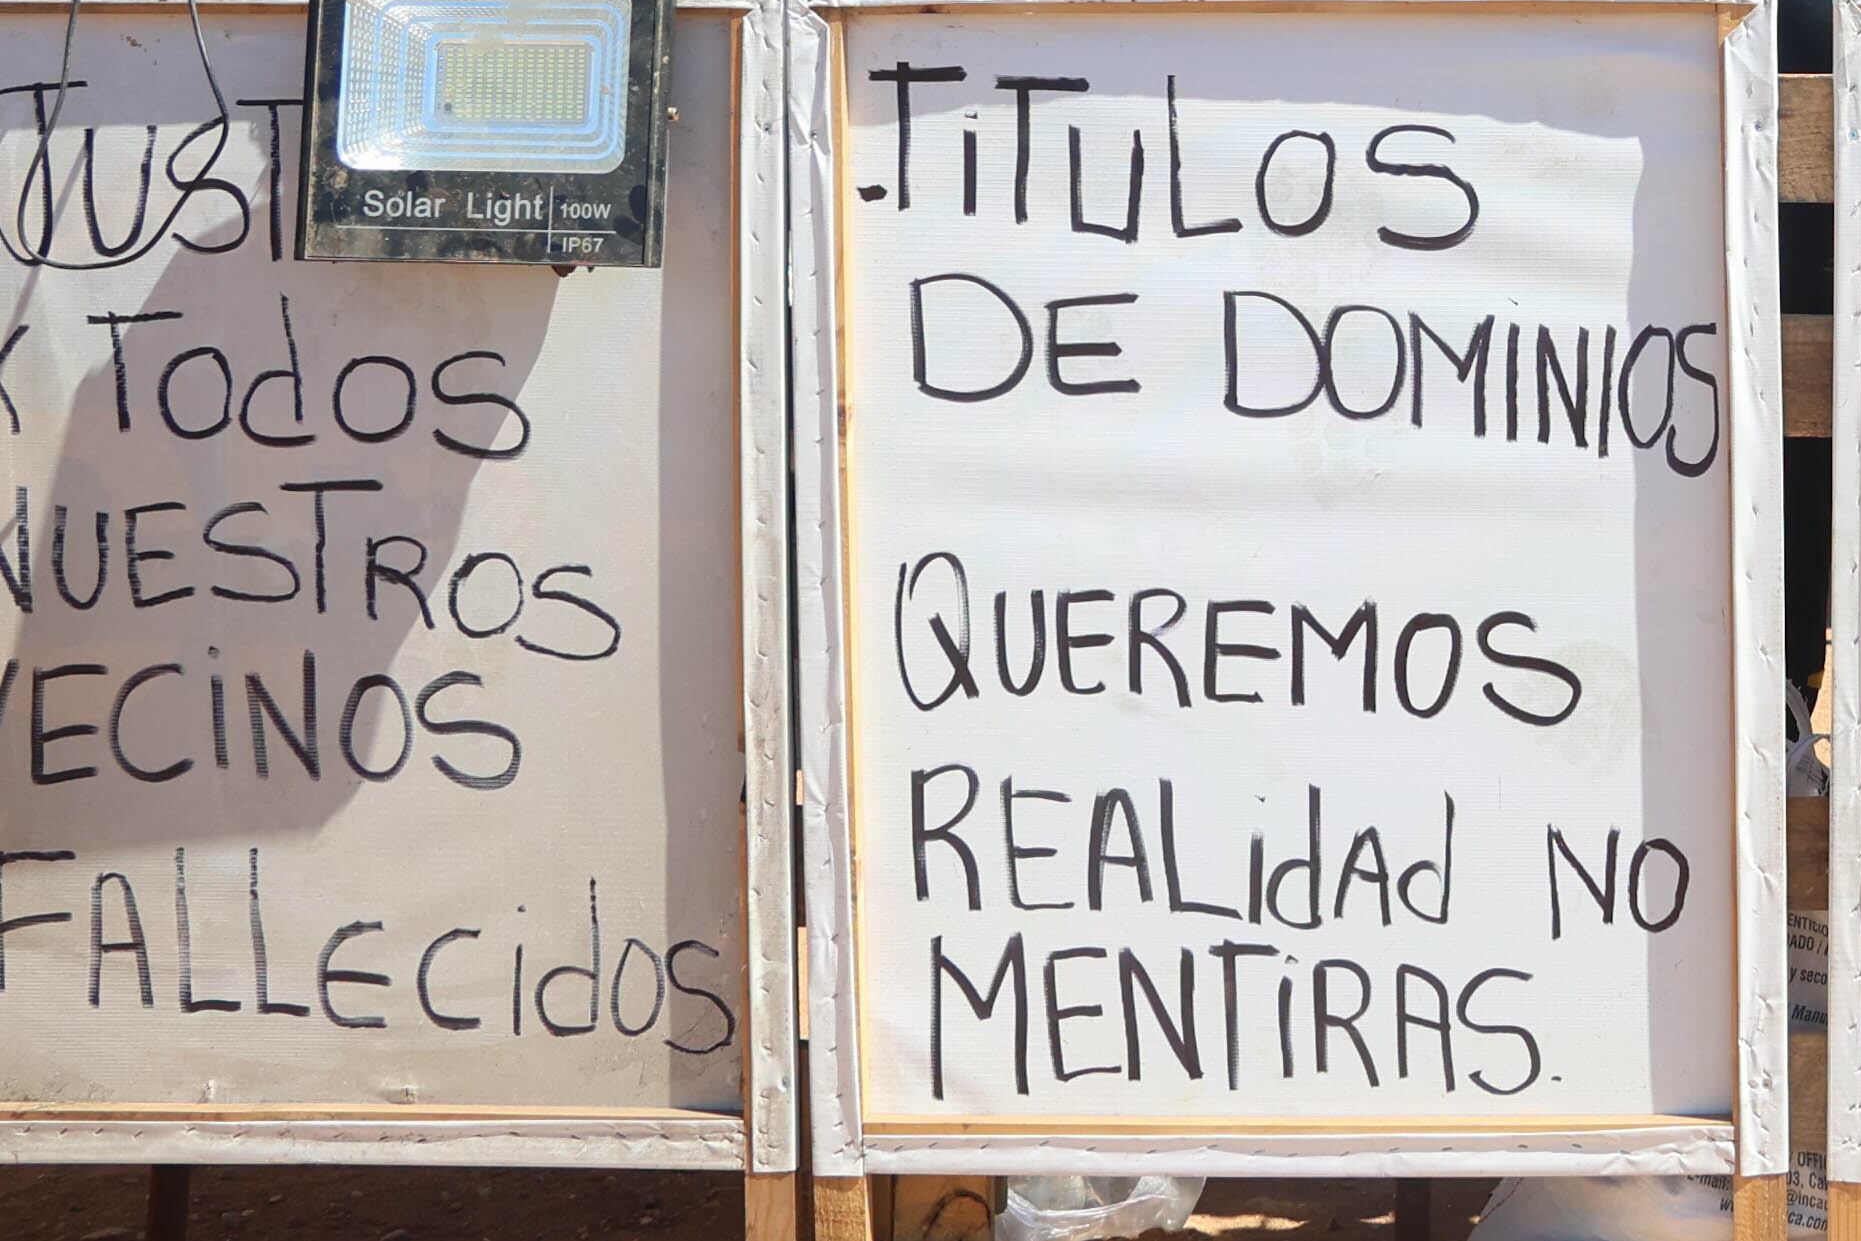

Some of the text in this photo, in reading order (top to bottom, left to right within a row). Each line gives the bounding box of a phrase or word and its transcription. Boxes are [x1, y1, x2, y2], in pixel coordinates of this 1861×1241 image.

[363, 190, 543, 227] Solar Light
[559, 203, 611, 220] 100W
[562, 237, 604, 254] IP67
[910, 272, 1141, 403] DE
[894, 551, 1583, 728] QUEREMOS
[1546, 824, 1691, 941] NO
